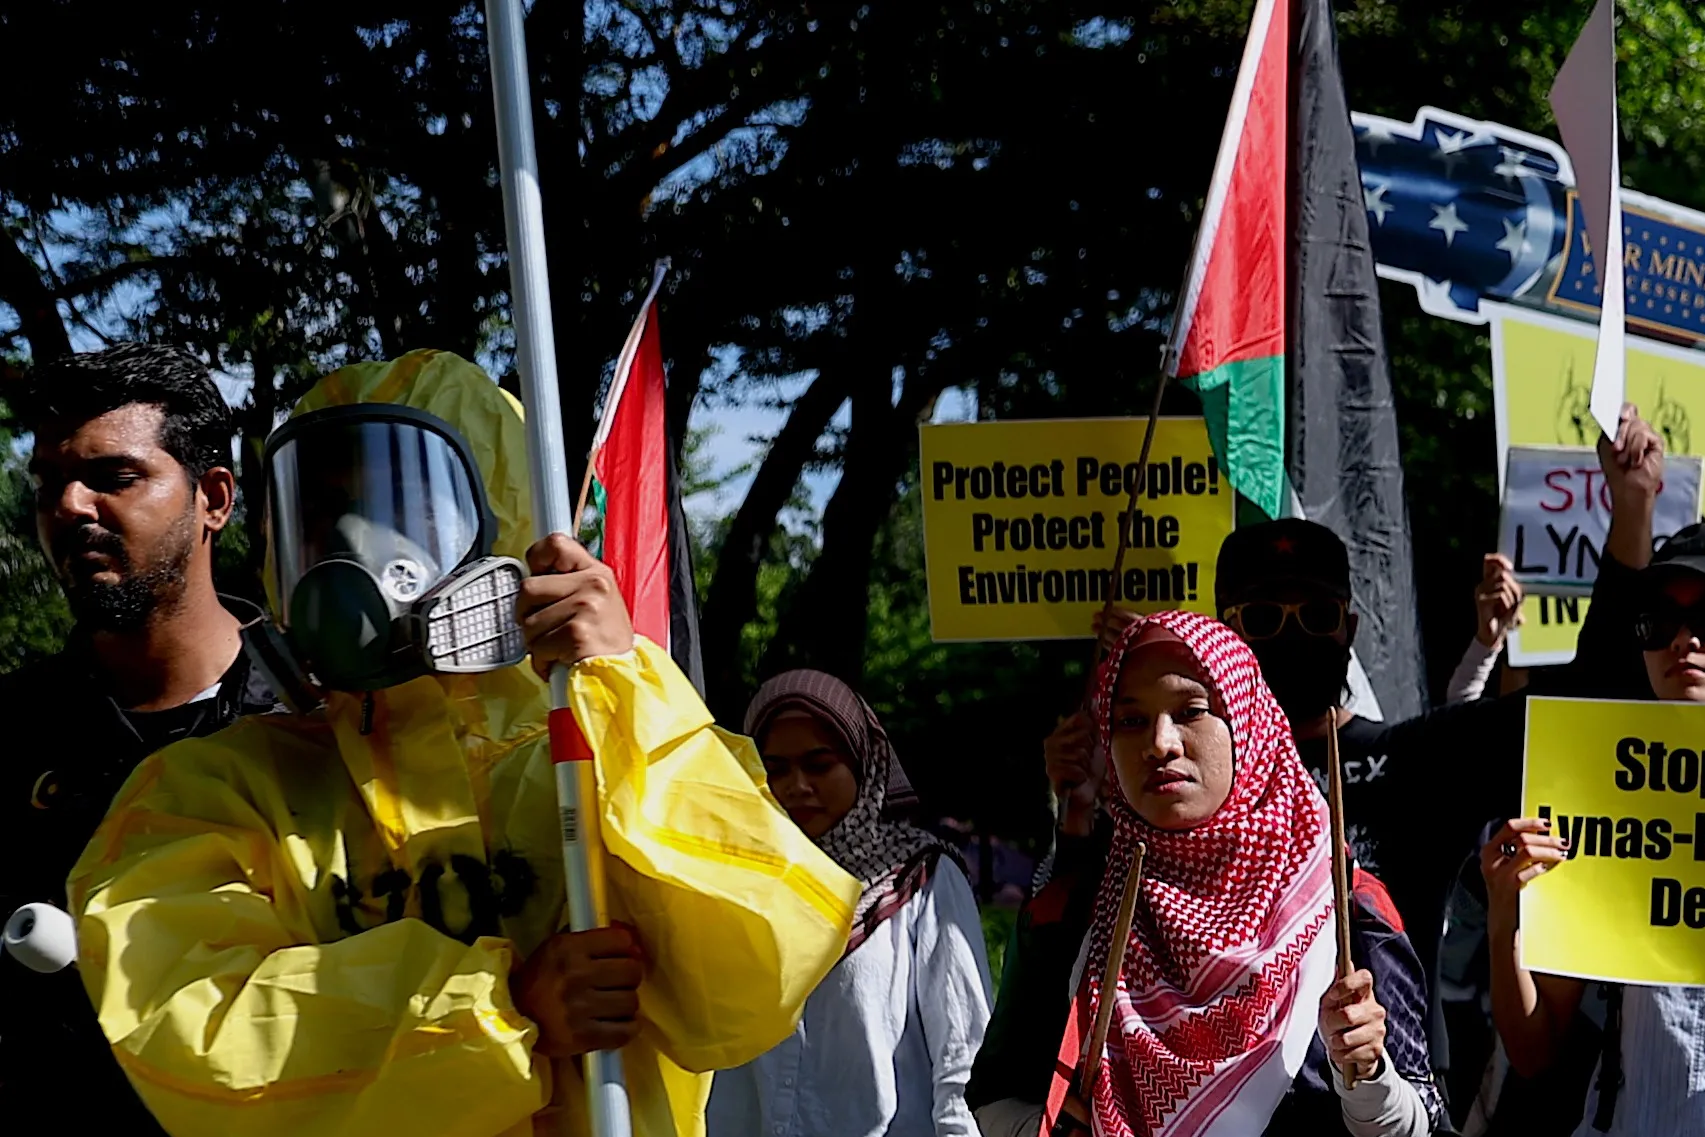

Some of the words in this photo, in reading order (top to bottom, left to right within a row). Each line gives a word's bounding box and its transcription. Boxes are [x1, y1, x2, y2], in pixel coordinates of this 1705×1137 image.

[1581, 261, 1705, 309] PCESSED
[932, 460, 1064, 500] Protect
[1076, 455, 1219, 500] People!
[972, 511, 1105, 552] Protect
[1117, 509, 1180, 549] the
[957, 562, 1199, 606] Environment!
